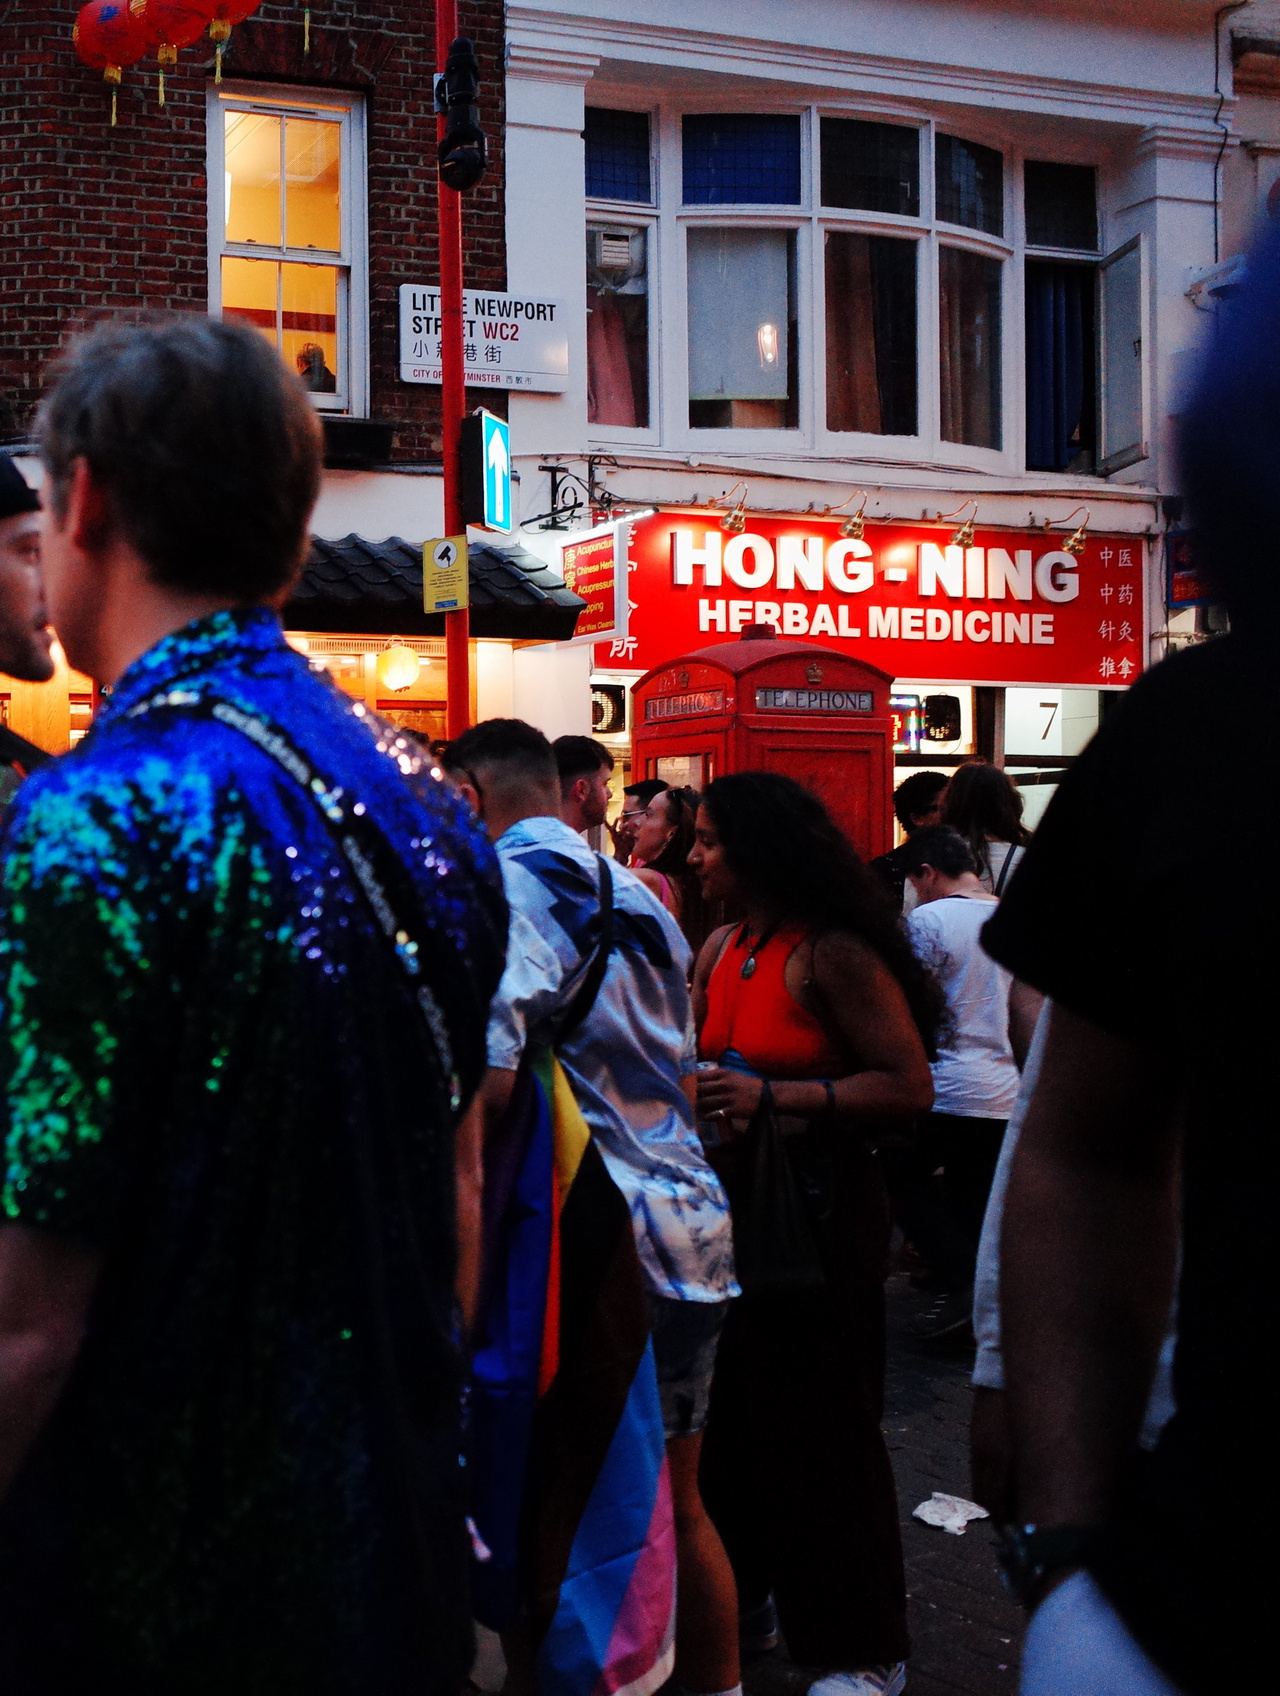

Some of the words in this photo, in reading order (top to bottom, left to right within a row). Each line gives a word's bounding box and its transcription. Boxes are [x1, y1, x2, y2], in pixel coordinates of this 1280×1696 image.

[412, 292, 468, 315] LITE
[475, 298, 556, 322] NEWPORT
[412, 316, 476, 338] STRT
[482, 321, 519, 341] WC2
[413, 368, 430, 378] CITY
[577, 539, 614, 556] Acupunctur
[1099, 546, 1134, 568] 中医
[577, 564, 600, 576] Chinese
[600, 559, 614, 570] Herb
[577, 579, 614, 595] Acupressur
[1100, 583, 1134, 605] 中药
[597, 620, 614, 630] Cleanin
[698, 599, 861, 639] HERBAL
[868, 605, 1055, 646] MEDICINE
[1098, 620, 1135, 642] 针灸
[1098, 657, 1136, 679] 推拿
[760, 690, 870, 710] TELEPHONE
[1039, 702, 1059, 740] 7
